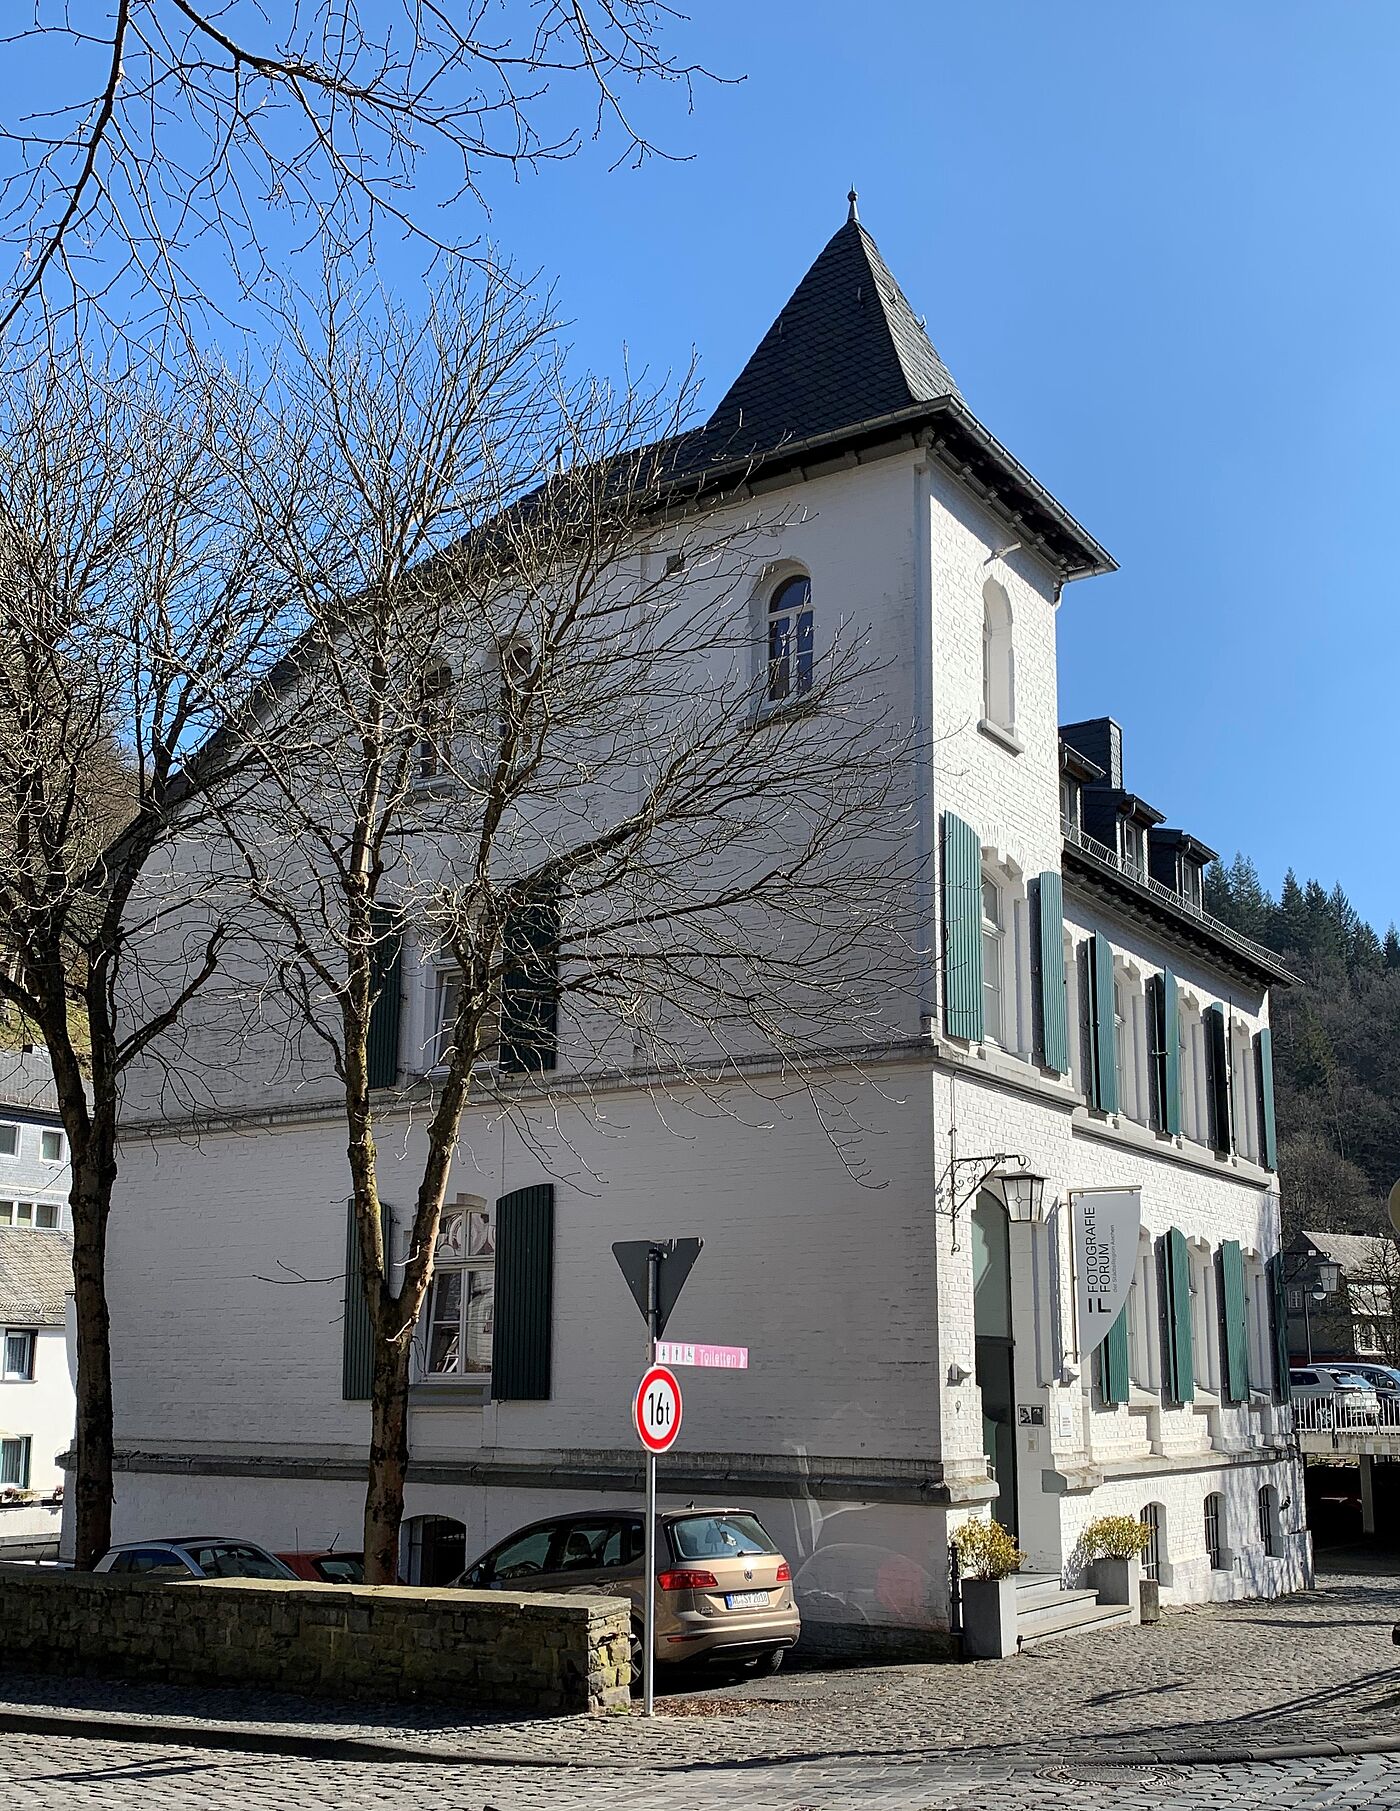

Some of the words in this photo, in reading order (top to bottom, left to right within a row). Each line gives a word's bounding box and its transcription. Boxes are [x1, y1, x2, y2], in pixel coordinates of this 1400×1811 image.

[1084, 1206, 1098, 1293] FOTOGRAFIE
[1098, 1243, 1111, 1293] FORUM
[700, 1349, 737, 1366] Toiletten
